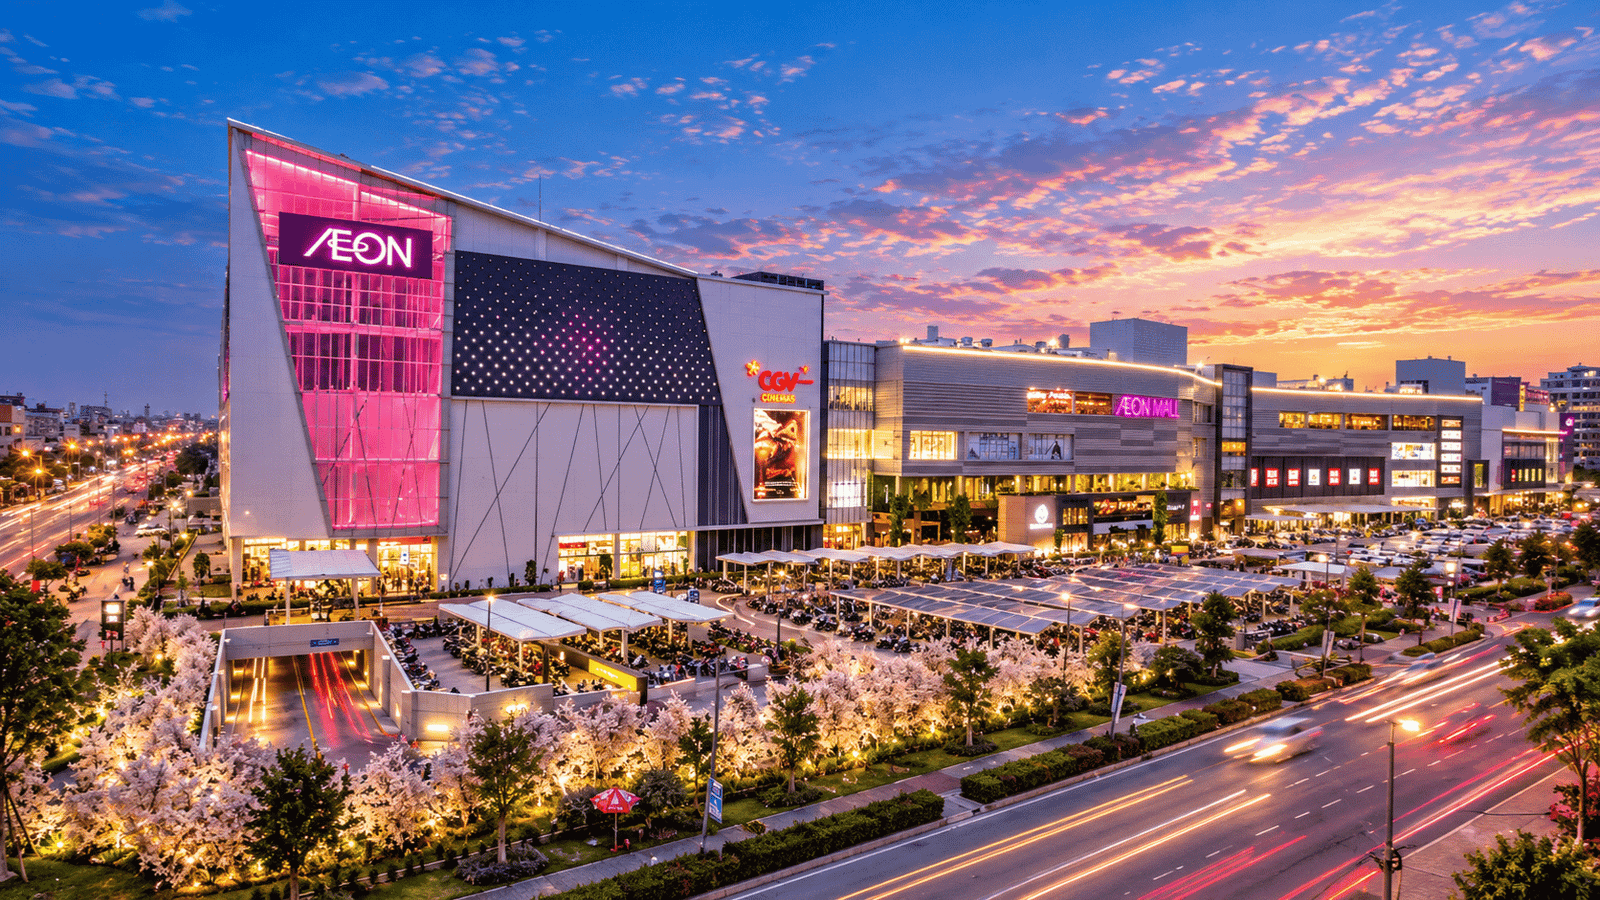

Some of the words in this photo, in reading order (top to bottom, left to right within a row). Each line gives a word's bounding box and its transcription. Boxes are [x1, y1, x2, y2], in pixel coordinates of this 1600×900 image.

[758, 370, 801, 392] CGV
[761, 393, 796, 404] CINEMAS
[1152, 398, 1180, 418] MALL
